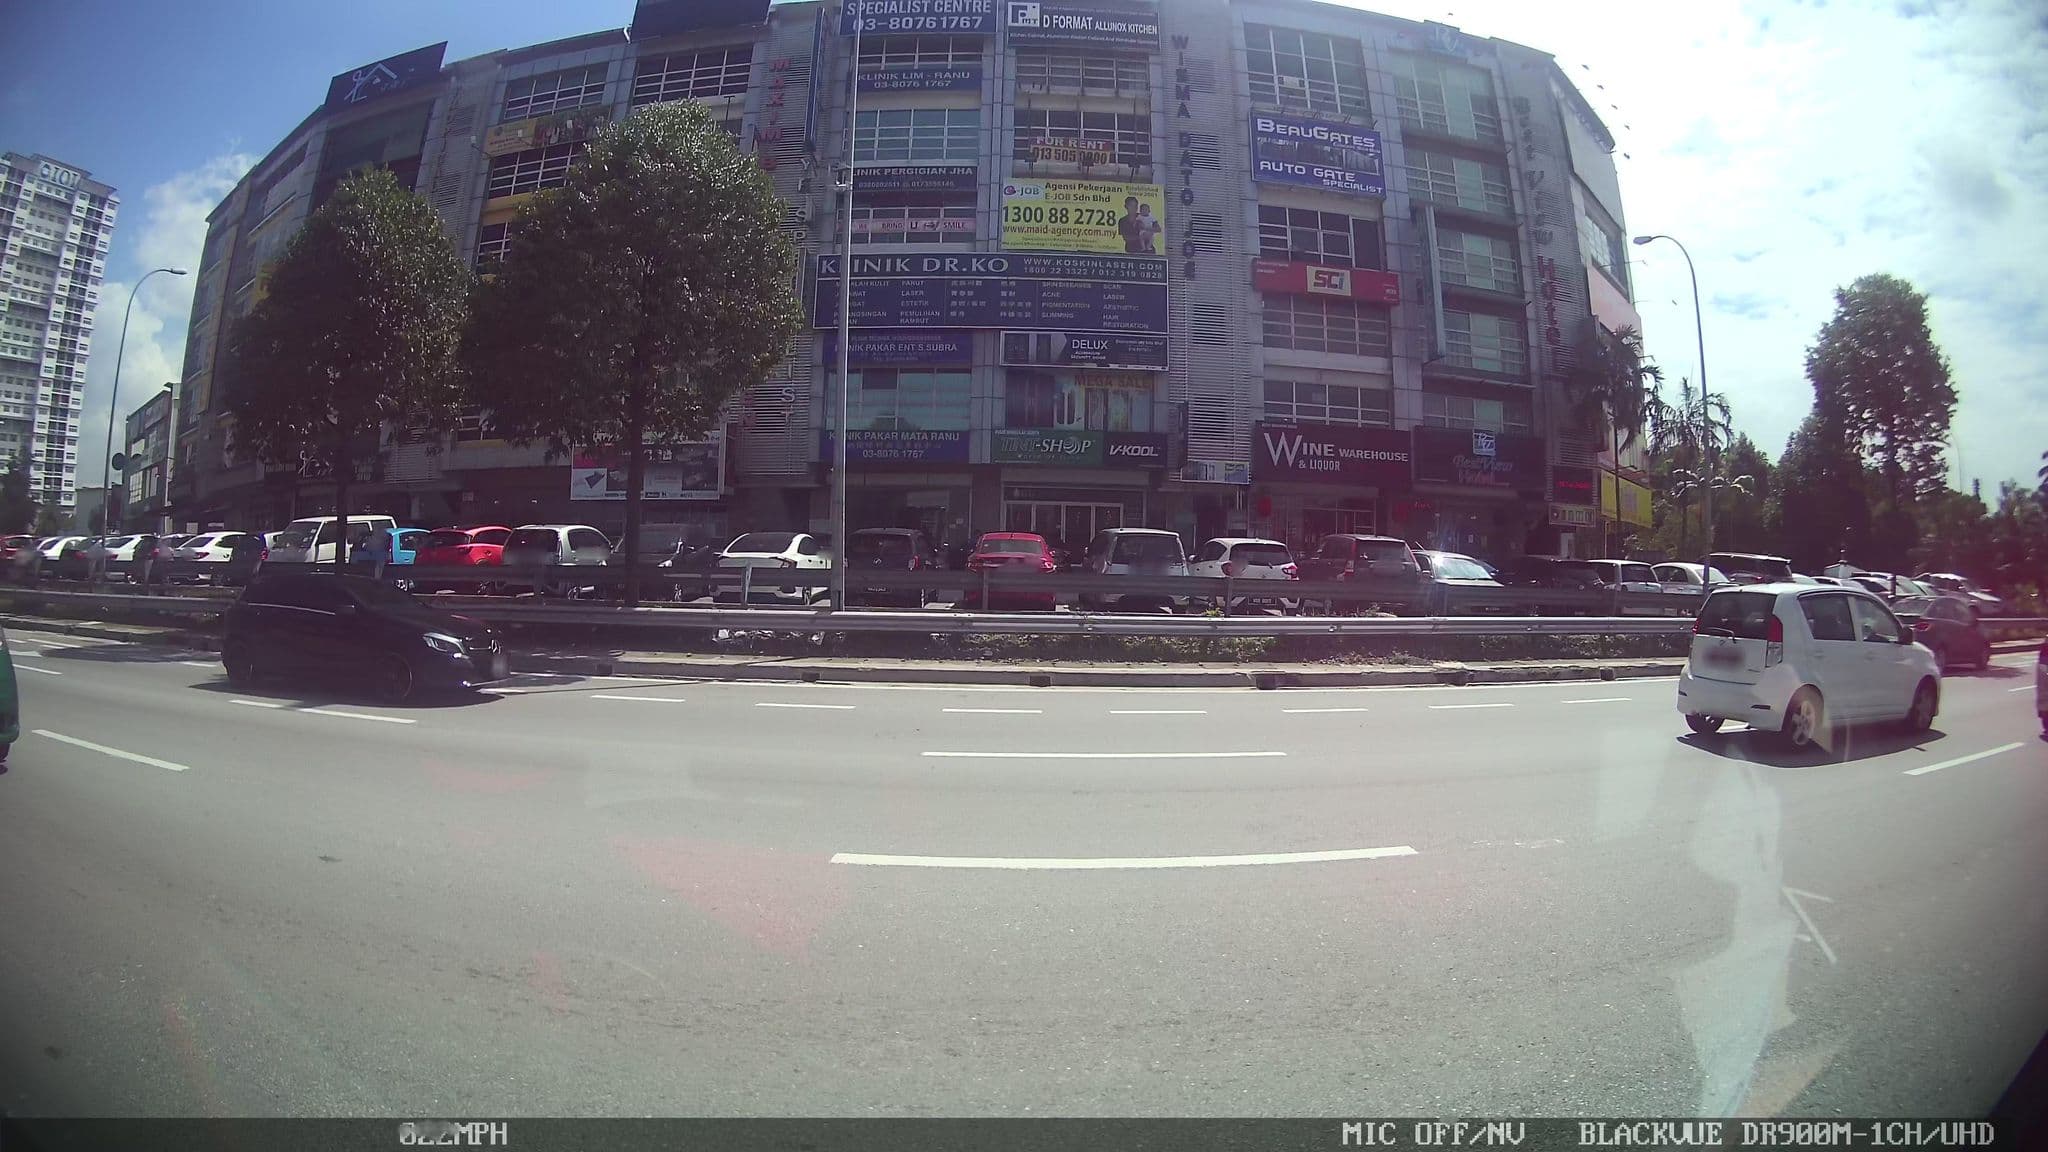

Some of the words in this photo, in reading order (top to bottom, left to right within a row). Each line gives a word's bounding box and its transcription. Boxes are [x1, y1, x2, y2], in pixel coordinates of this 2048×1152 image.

[847, 0, 932, 15] SPECIALIST
[934, 0, 991, 13] CENTRE
[1043, 15, 1050, 28] D
[1053, 15, 1093, 30] FORMAT
[1128, 23, 1158, 35] KITCHEN
[858, 72, 898, 81] KLINIK
[935, 71, 970, 79] RANU
[1036, 136, 1064, 146] FOR
[1068, 139, 1106, 151] RENT
[884, 167, 947, 176] PERGIGIAN
[950, 167, 973, 175] JHA
[1260, 160, 1306, 175] AUTO
[1313, 167, 1356, 182] GATE
[1045, 182, 1076, 192] Agensi
[1078, 184, 1123, 195] Pekerjaan
[1322, 179, 1384, 193] SPECIALIST
[1073, 194, 1091, 202] Sdn
[1093, 195, 1111, 203] Bhd
[1003, 205, 1044, 223] 1300
[1048, 207, 1069, 224] 88
[1074, 209, 1116, 227] 2728
[1003, 225, 1117, 239] www.maid-agency.com.my
[821, 257, 911, 274] KINIK
[865, 343, 896, 352] PAKAR
[898, 343, 915, 352] ENT
[1072, 340, 1108, 350] DELUX
[864, 431, 898, 441] PAKAR
[900, 431, 929, 441] MATA
[931, 431, 960, 441] RANU
[1109, 445, 1159, 457] V-KOOL
[1338, 447, 1409, 462] WAREHOUSE
[1298, 461, 1306, 469] &
[1309, 460, 1341, 472] LIQUOR
